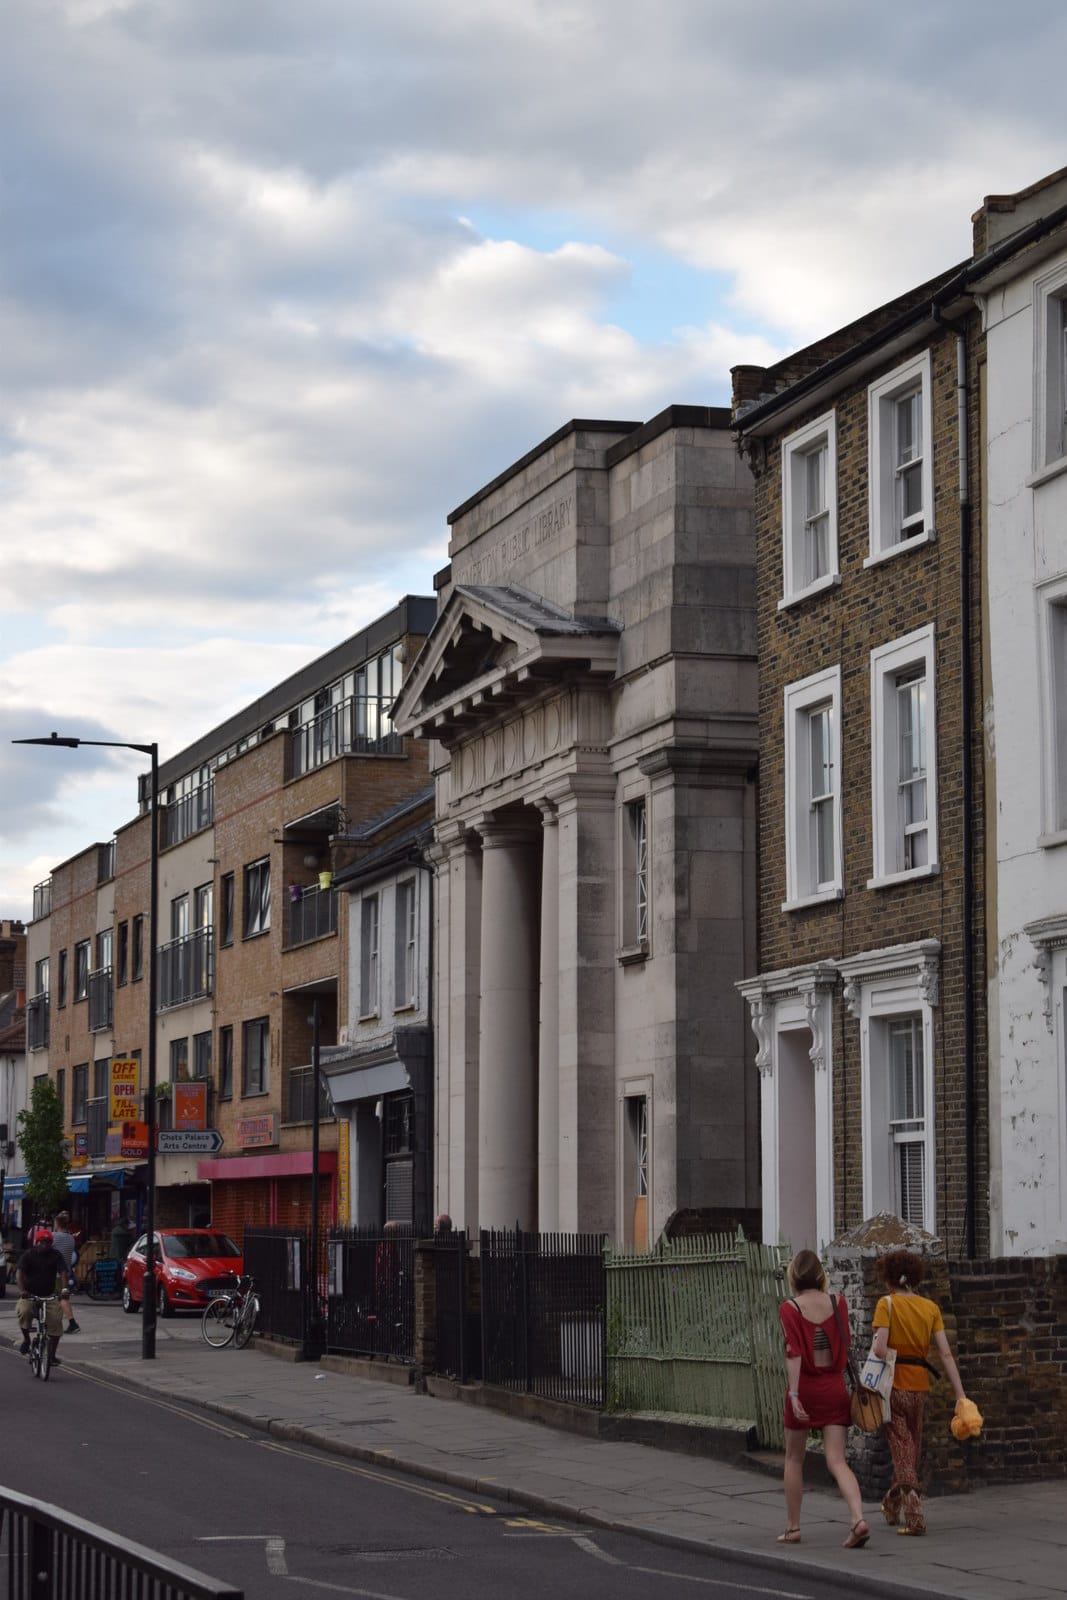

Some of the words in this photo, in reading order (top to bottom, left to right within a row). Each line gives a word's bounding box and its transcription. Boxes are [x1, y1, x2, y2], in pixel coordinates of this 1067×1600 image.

[502, 527, 531, 569] PUBLIC
[533, 496, 572, 546] LIBRARY
[112, 1062, 137, 1074] OFF
[114, 1084, 136, 1096] OPEN
[115, 1099, 134, 1109] TILL
[112, 1108, 137, 1118] LATE
[160, 1133, 182, 1141] Chats
[185, 1133, 210, 1141] Palace
[121, 1148, 143, 1157] SOLD
